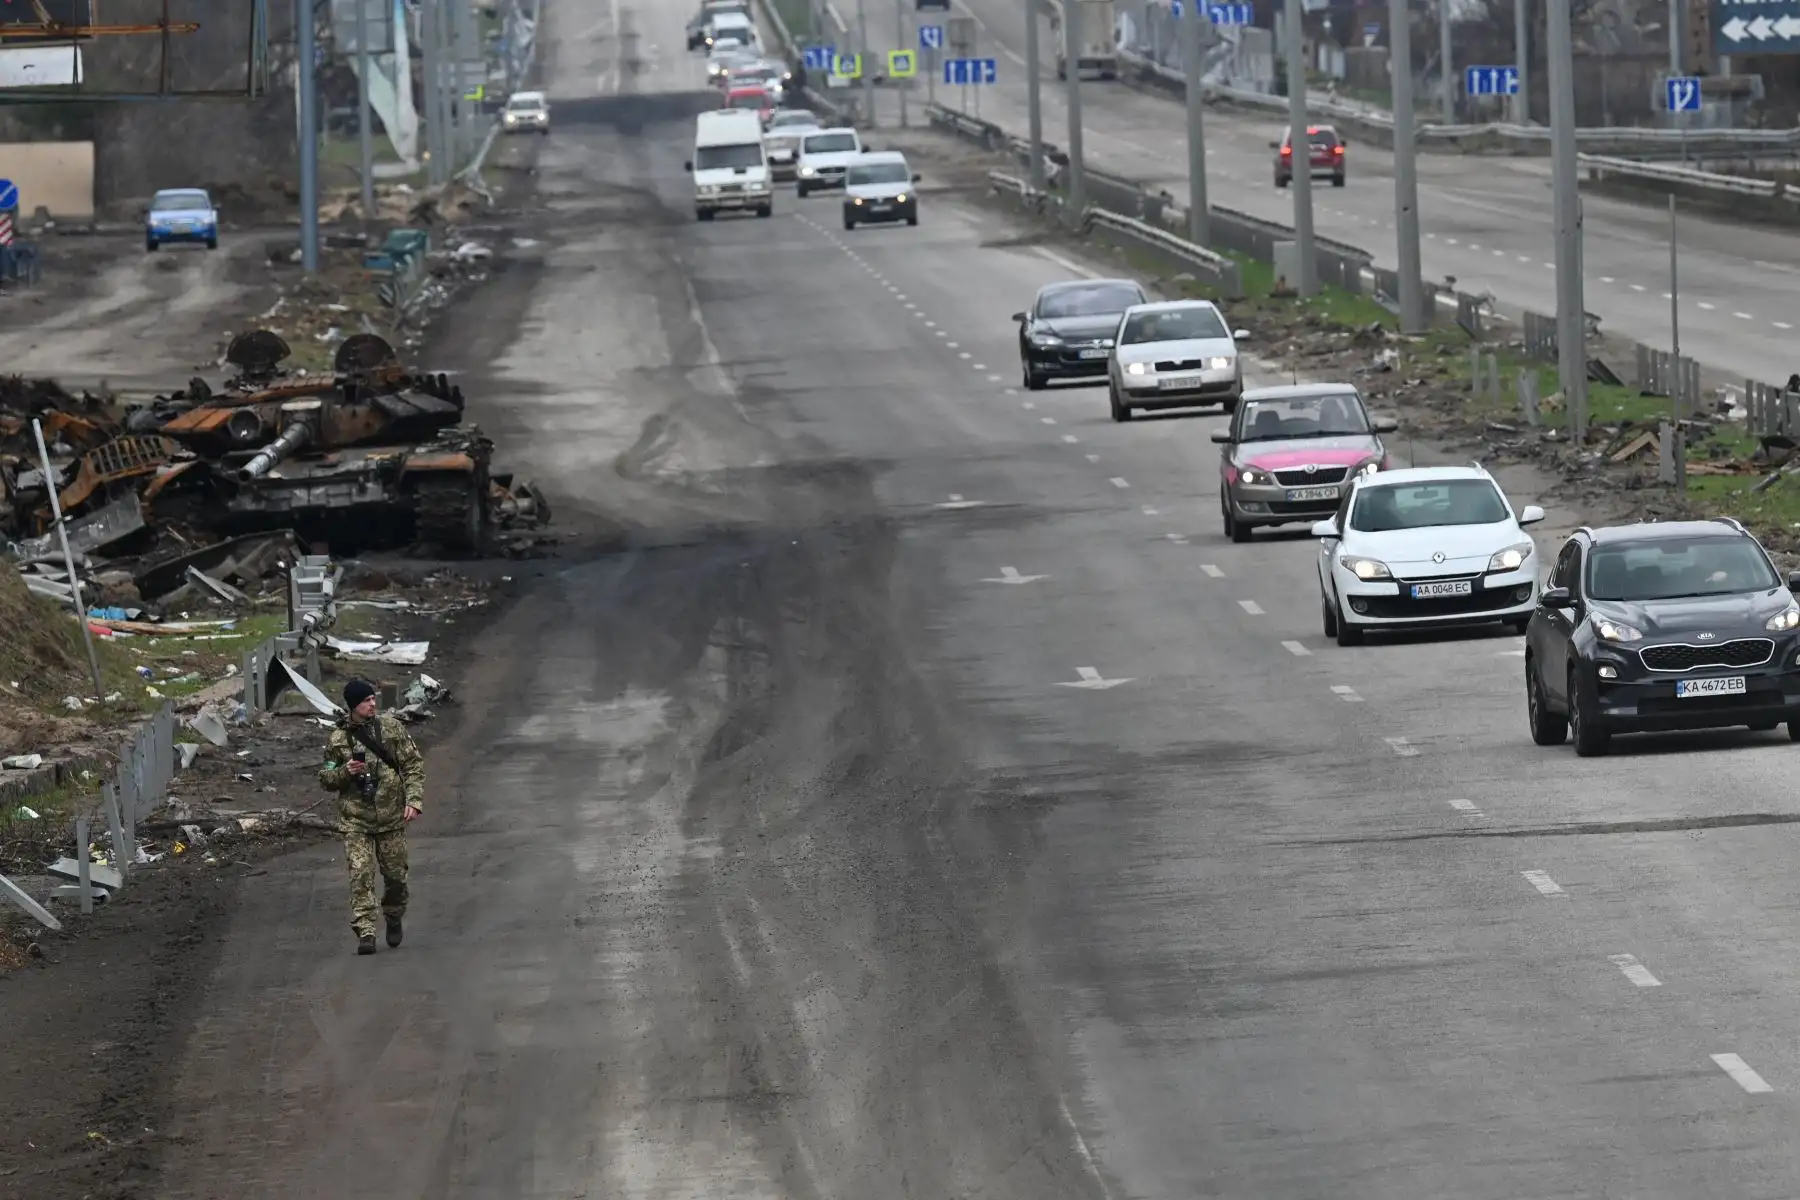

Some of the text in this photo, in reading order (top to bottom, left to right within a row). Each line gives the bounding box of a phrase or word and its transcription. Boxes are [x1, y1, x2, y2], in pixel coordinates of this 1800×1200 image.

[1417, 582, 1469, 596] AA 0048 EC
[1683, 678, 1744, 693] KA 4672 EB
